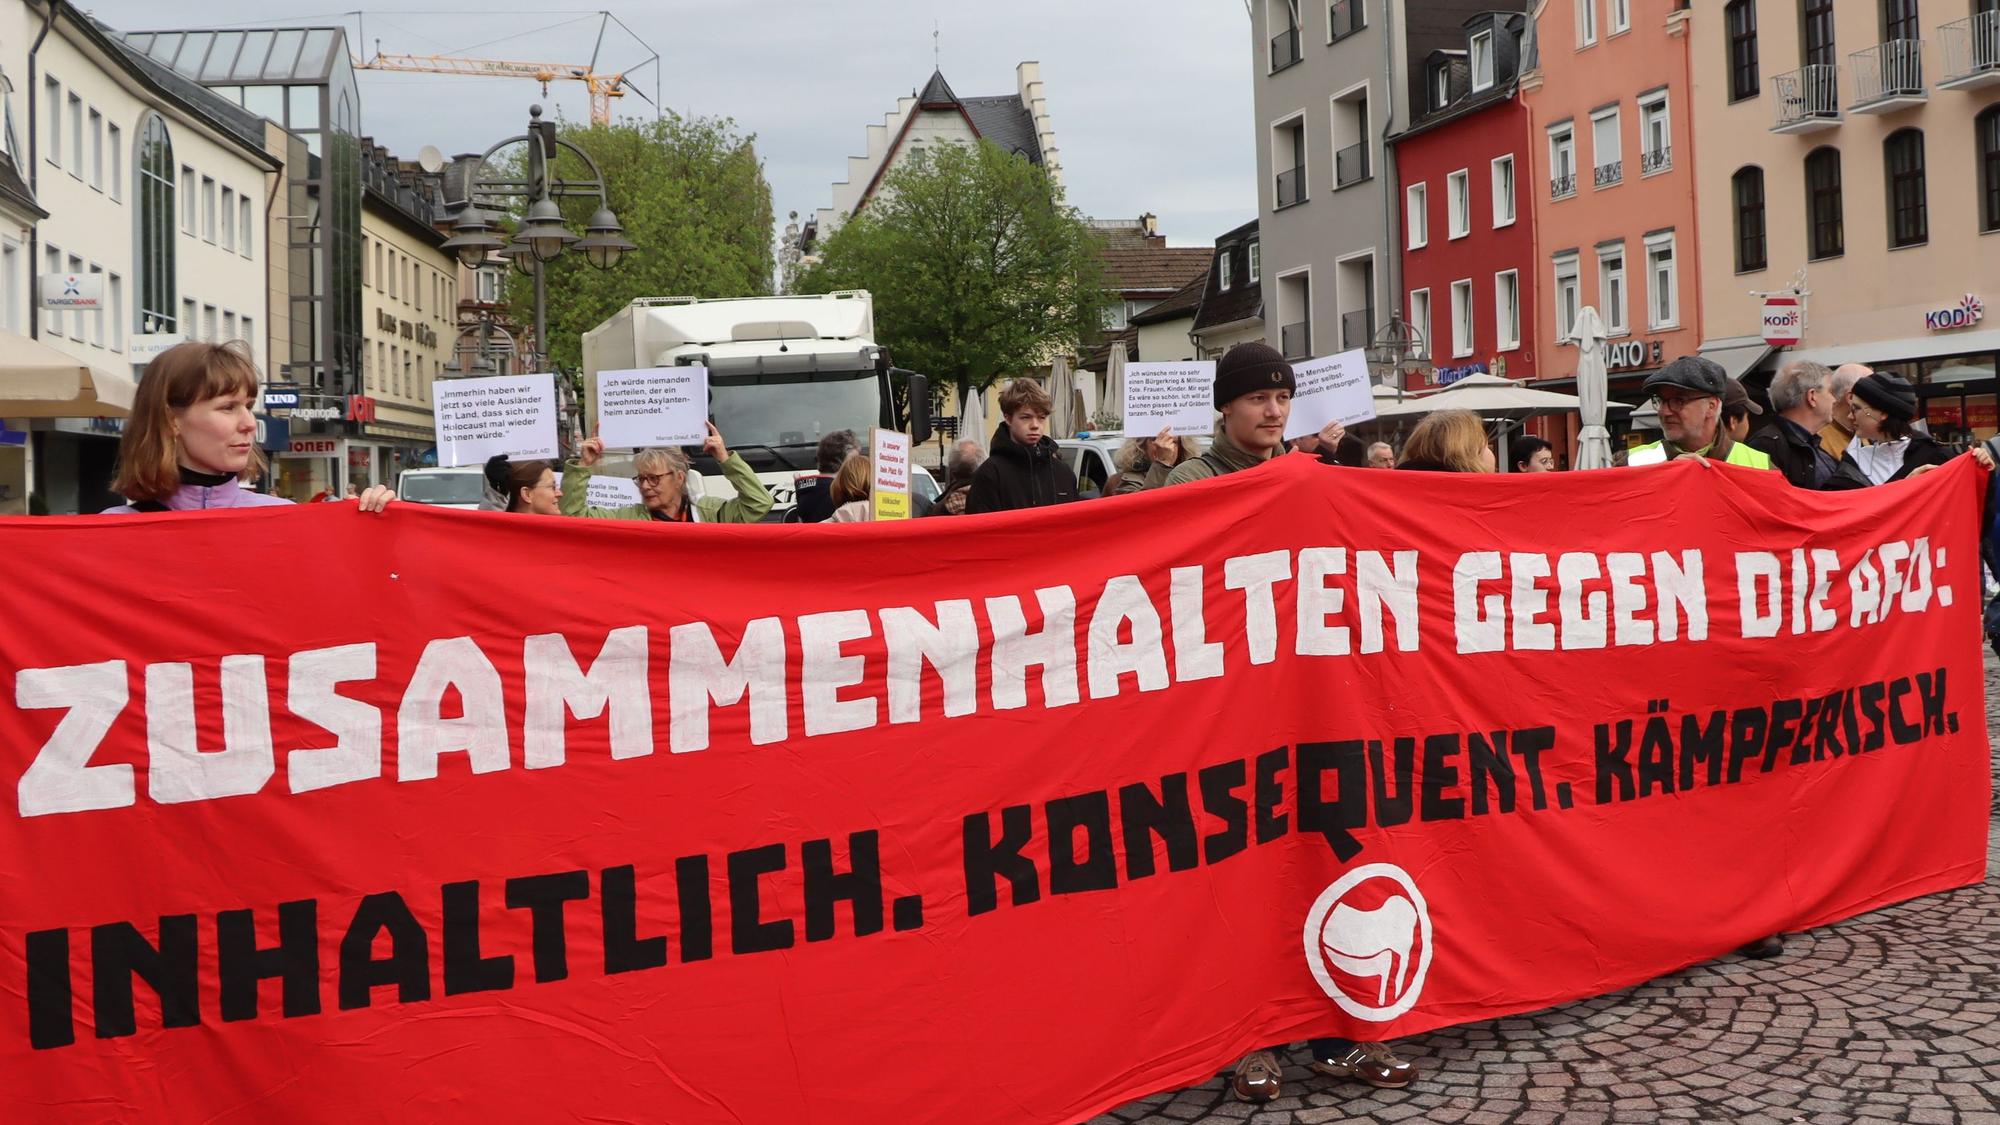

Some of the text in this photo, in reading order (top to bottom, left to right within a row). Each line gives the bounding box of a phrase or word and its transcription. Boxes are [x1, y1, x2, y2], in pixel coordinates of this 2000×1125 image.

[621, 378, 645, 386] würde
[647, 376, 691, 385] niemanden
[488, 386, 516, 396] haben
[517, 385, 532, 394] wir
[649, 387, 662, 395] der
[264, 393, 298, 405] KIND
[440, 396, 542, 412] jetzt so viele Ausländer
[603, 396, 691, 407] bewohntes Asylanten-
[482, 409, 503, 418] dass
[505, 407, 524, 416] sich
[525, 407, 540, 415] ein
[603, 409, 623, 417] heim
[1150, 409, 1164, 417] Sieg
[489, 419, 506, 428] mal
[507, 418, 537, 427] wieder
[16, 546, 1419, 817] ZUSAMMENHALTEN
[1452, 549, 1709, 655] GEGEN
[1734, 548, 1841, 638] DIE
[26, 667, 1960, 1050] INHALTLICH. KONSEQUENT. KÄMPFERISCH.
